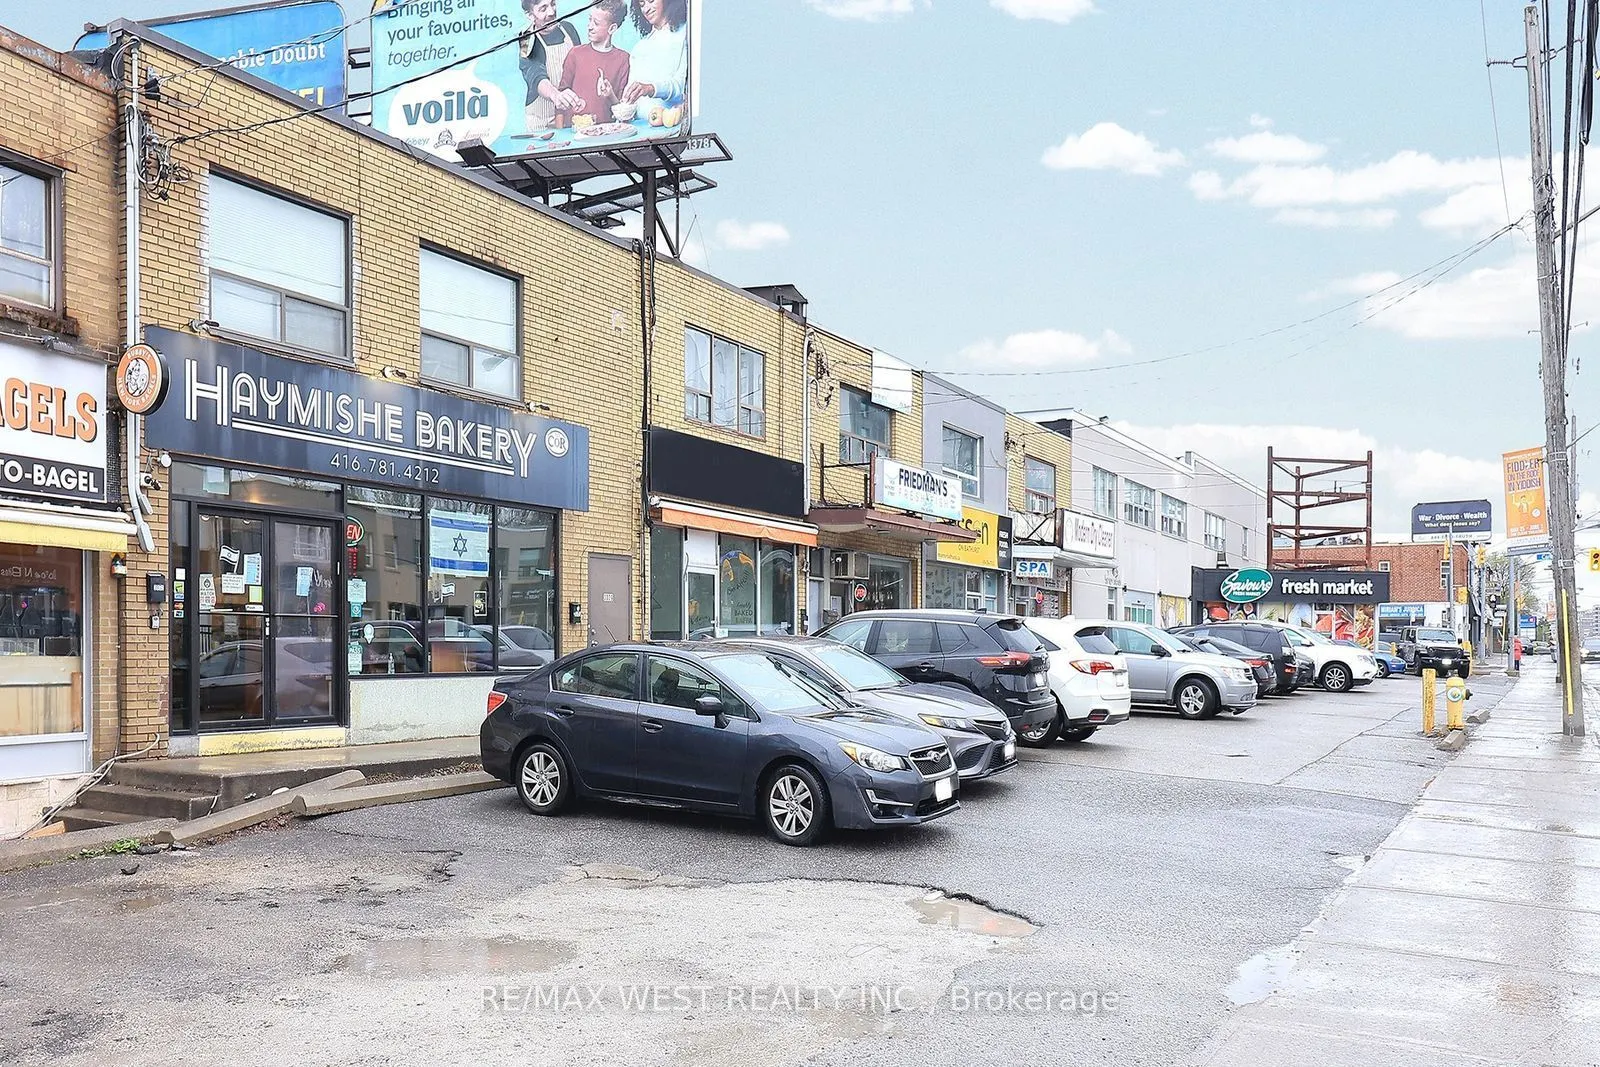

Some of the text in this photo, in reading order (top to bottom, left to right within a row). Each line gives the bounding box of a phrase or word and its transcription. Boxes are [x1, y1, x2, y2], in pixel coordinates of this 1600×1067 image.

[387, 13, 513, 46] your favourites,
[271, 40, 326, 65] Doubt
[387, 44, 457, 68] together.
[402, 86, 489, 126] voilà
[687, 138, 709, 150] 1378
[0, 377, 97, 443] GELS
[184, 358, 537, 478] HAYMISHE BAKERY
[330, 452, 440, 484] 416.781.4212
[898, 467, 948, 497] FRIEDMAN'S
[1418, 511, 1488, 522] War Divorce Wealth
[1019, 562, 1048, 573] SPA
[1282, 578, 1320, 594] fresh
[1322, 578, 1374, 595] market
